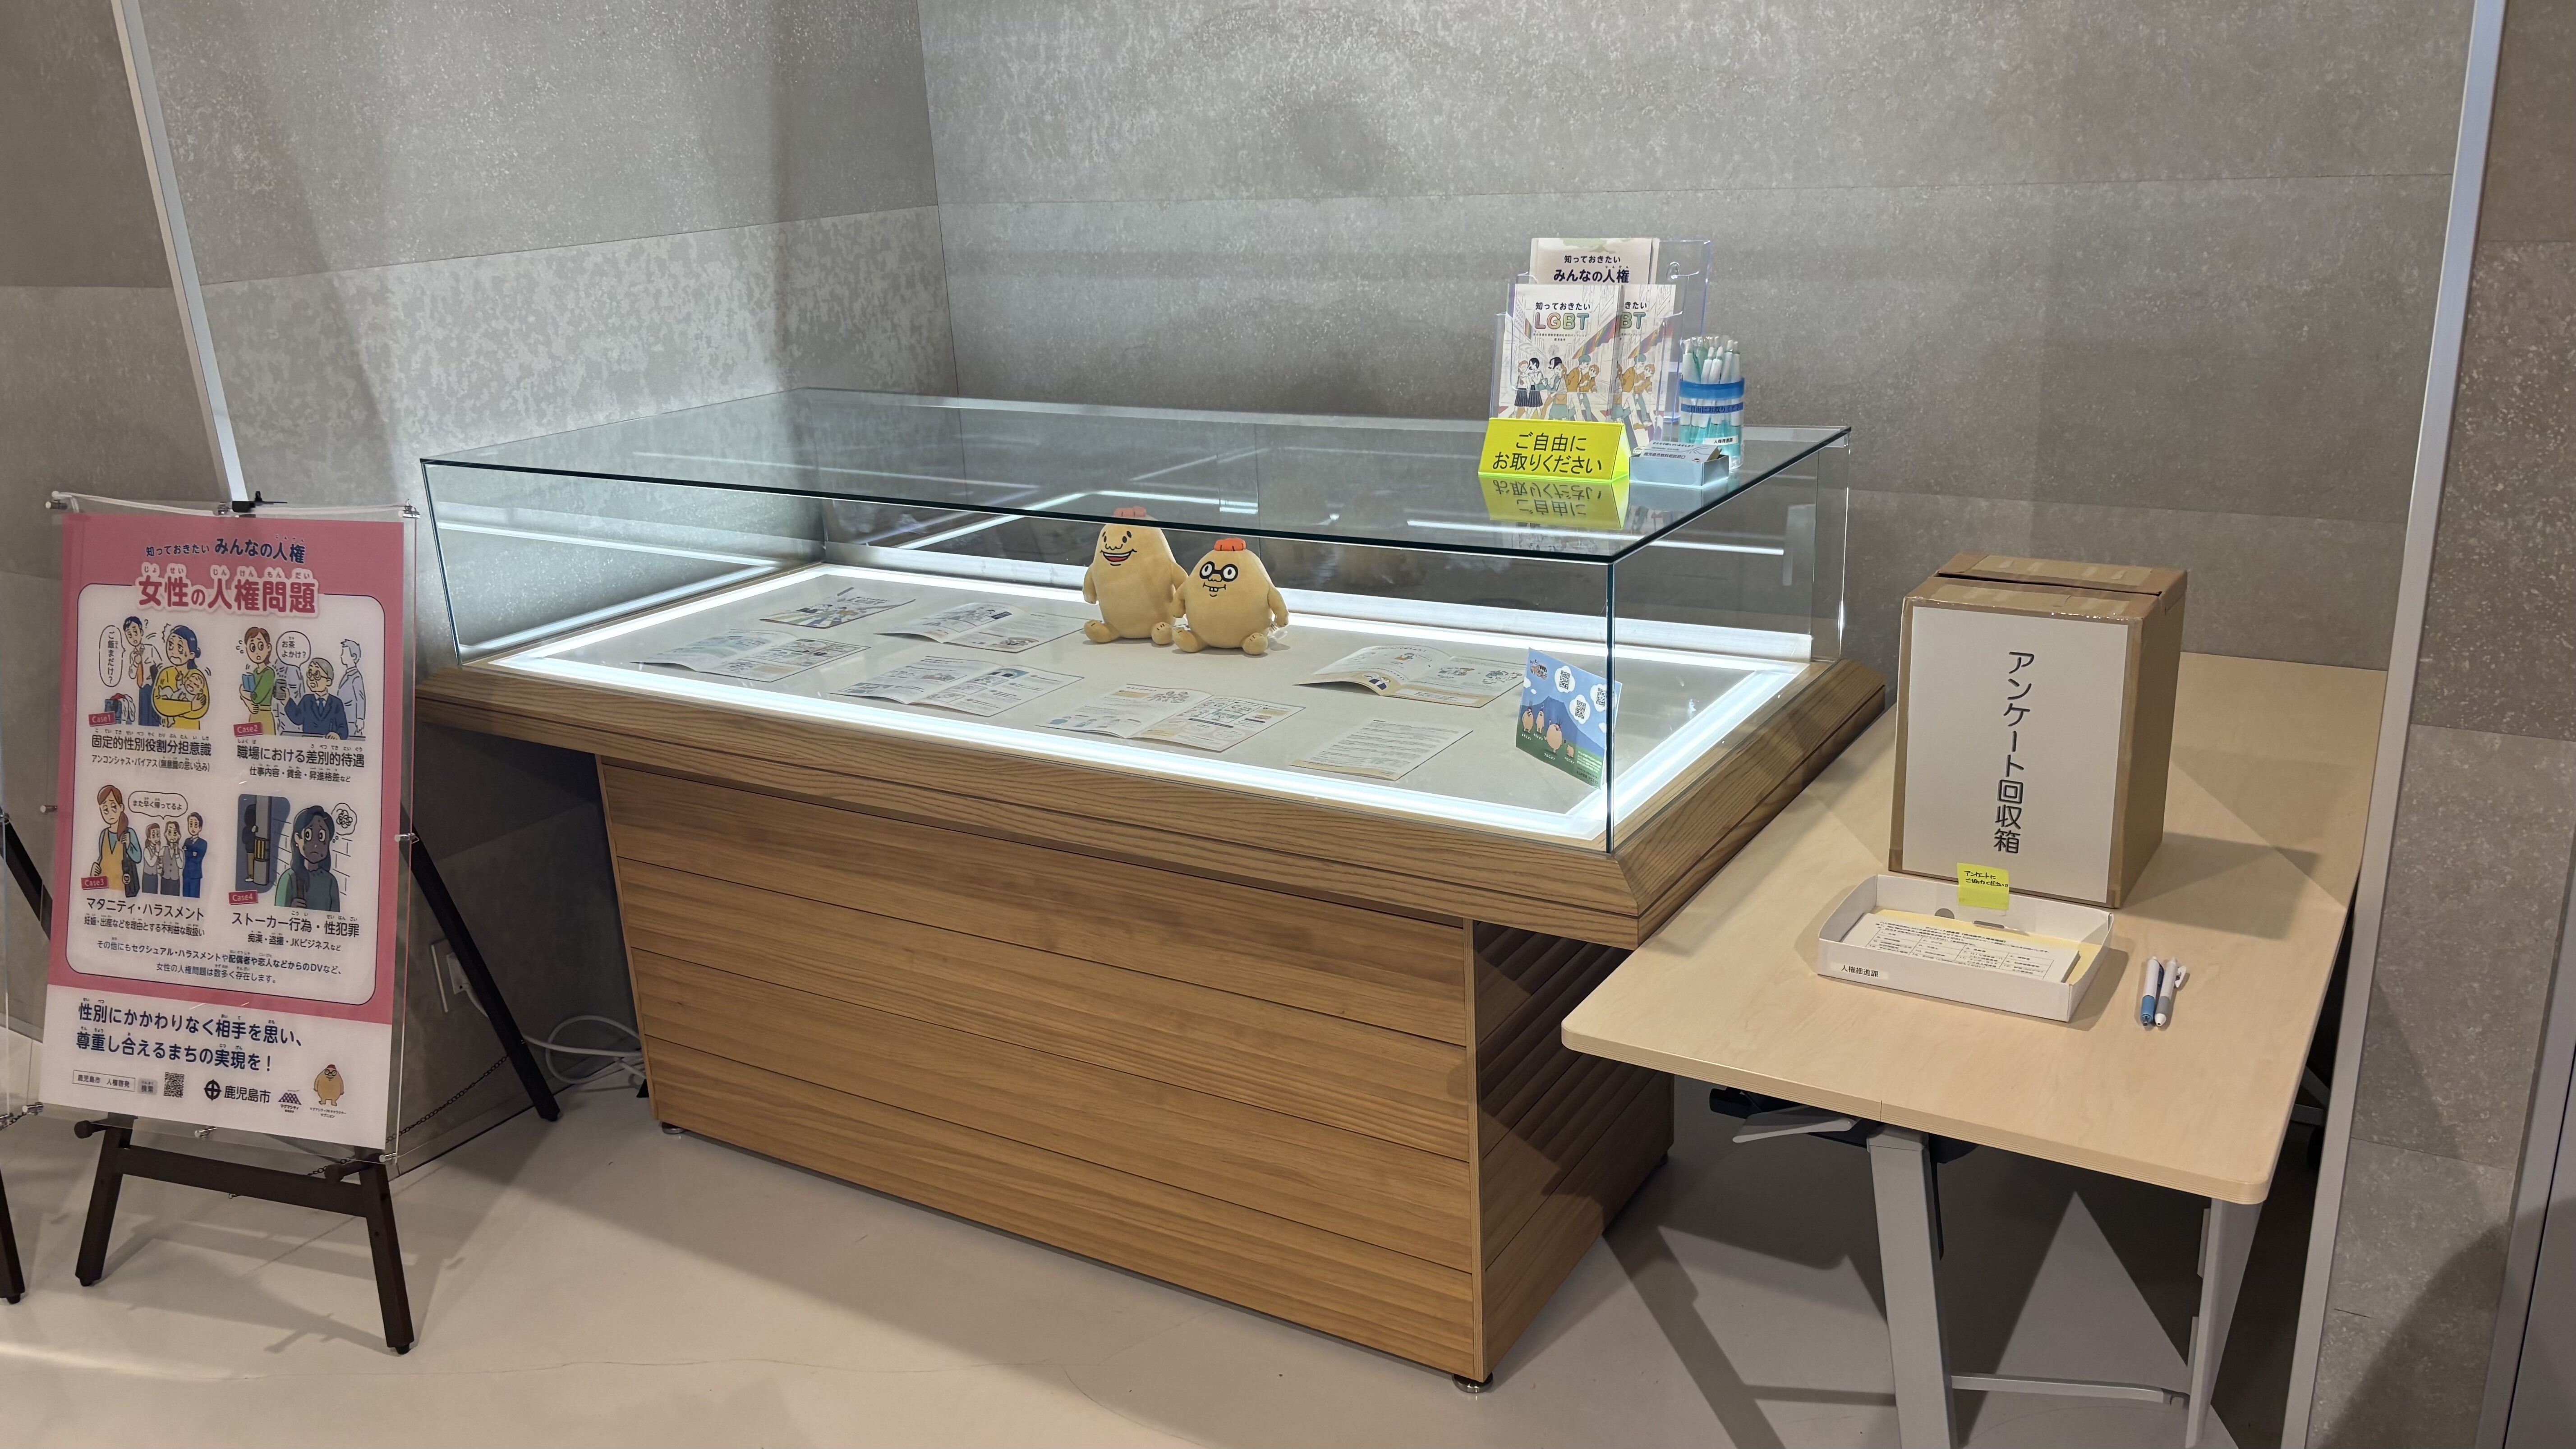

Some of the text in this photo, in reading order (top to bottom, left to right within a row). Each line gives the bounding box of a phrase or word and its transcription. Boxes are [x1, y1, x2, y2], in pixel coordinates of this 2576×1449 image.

[1564, 255, 1620, 263] 知っておきたい
[1554, 269, 1629, 283] みんなの人権
[1535, 302, 1590, 310] 知っておきたい
[1534, 312, 1589, 330] LGBT
[1516, 432, 1587, 452] ご自由に
[1493, 451, 1601, 474] お取りください
[146, 544, 209, 557] 知っておきたい
[215, 538, 305, 564] みんなの人権
[139, 575, 315, 613] 女性の人権問題
[237, 725, 258, 733] Case2
[92, 735, 212, 756] 固定的性別役割分担意識
[237, 745, 365, 768] 職場における差別的待遇
[1993, 650, 2034, 855] アンケート回収箱
[87, 898, 204, 921] マタニティ・ハラスメント
[232, 912, 360, 937] ストーカー行為・性犯罪
[78, 1002, 302, 1046] 性別にかかわりなく相手を思い、
[225, 1085, 271, 1104] 鹿児島市
